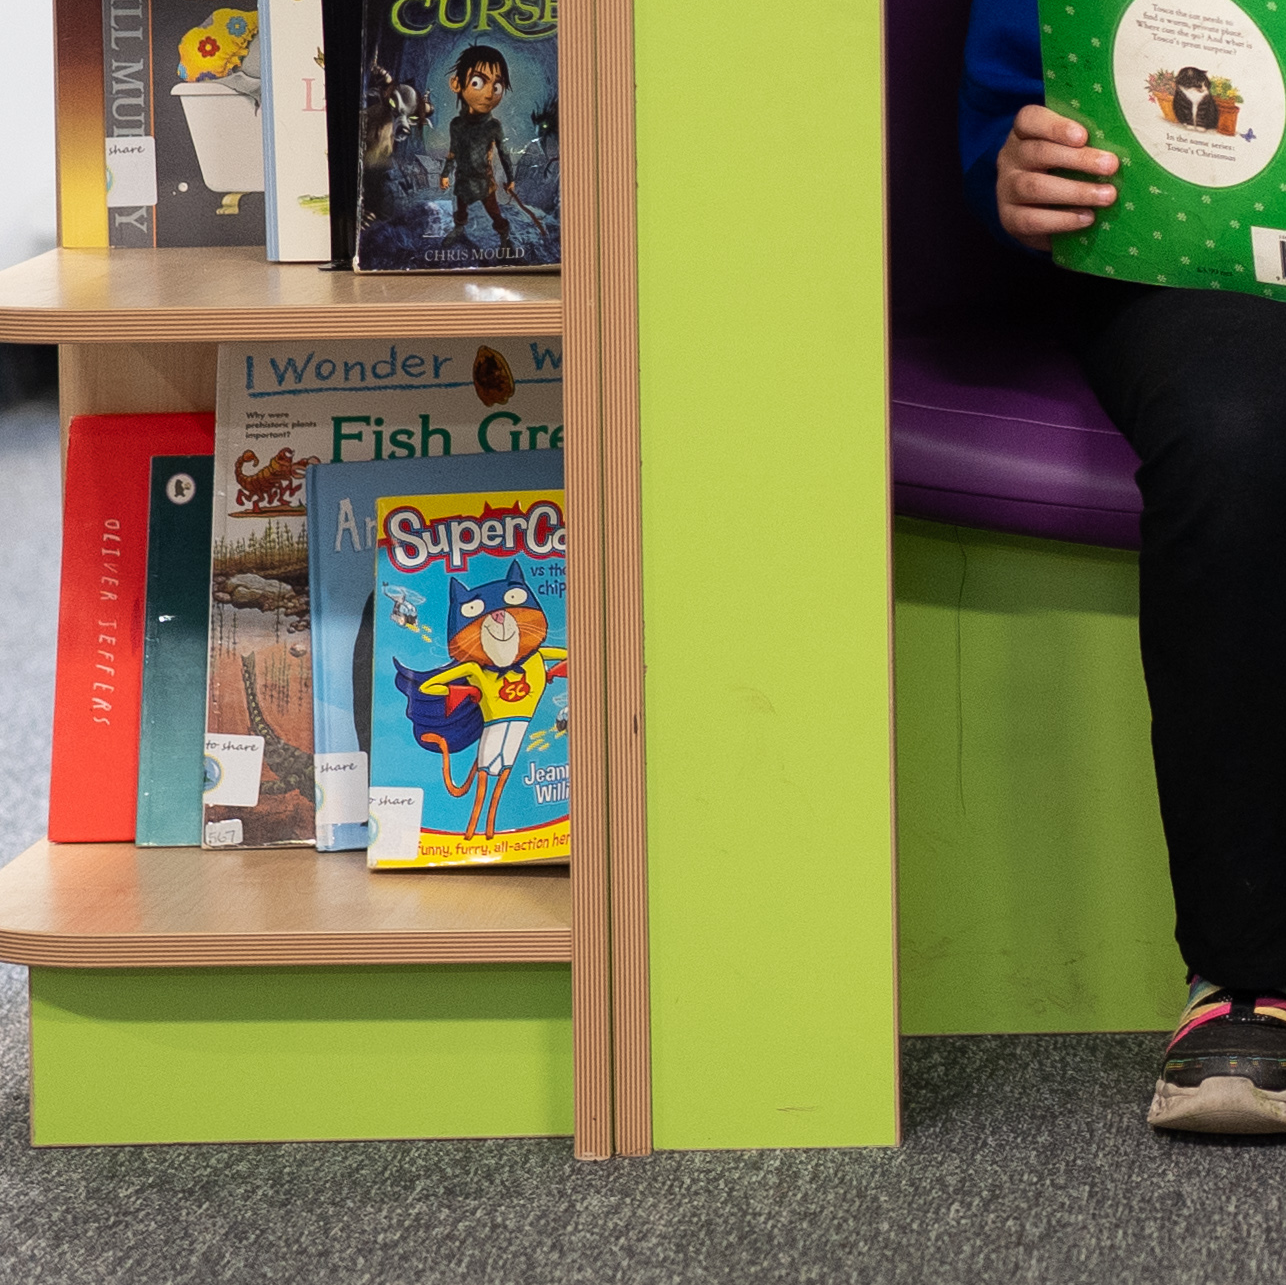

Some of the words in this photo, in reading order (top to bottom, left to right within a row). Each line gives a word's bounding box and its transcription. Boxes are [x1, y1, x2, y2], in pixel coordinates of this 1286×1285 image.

[424, 248, 469, 263] CHRIS
[472, 246, 526, 262] MOULD
[245, 355, 255, 391] I
[269, 344, 453, 387] Wonder
[246, 412, 266, 420] Why
[246, 420, 289, 430] prehistoric
[292, 419, 317, 429] plants
[245, 431, 291, 440] important?
[330, 413, 453, 463] Fish
[100, 517, 122, 602] OLIVER
[91, 618, 118, 727] JEFFERS
[504, 683, 526, 700] SC
[221, 741, 259, 752] share
[455, 844, 491, 857] furry,
[493, 837, 549, 854] all-action
